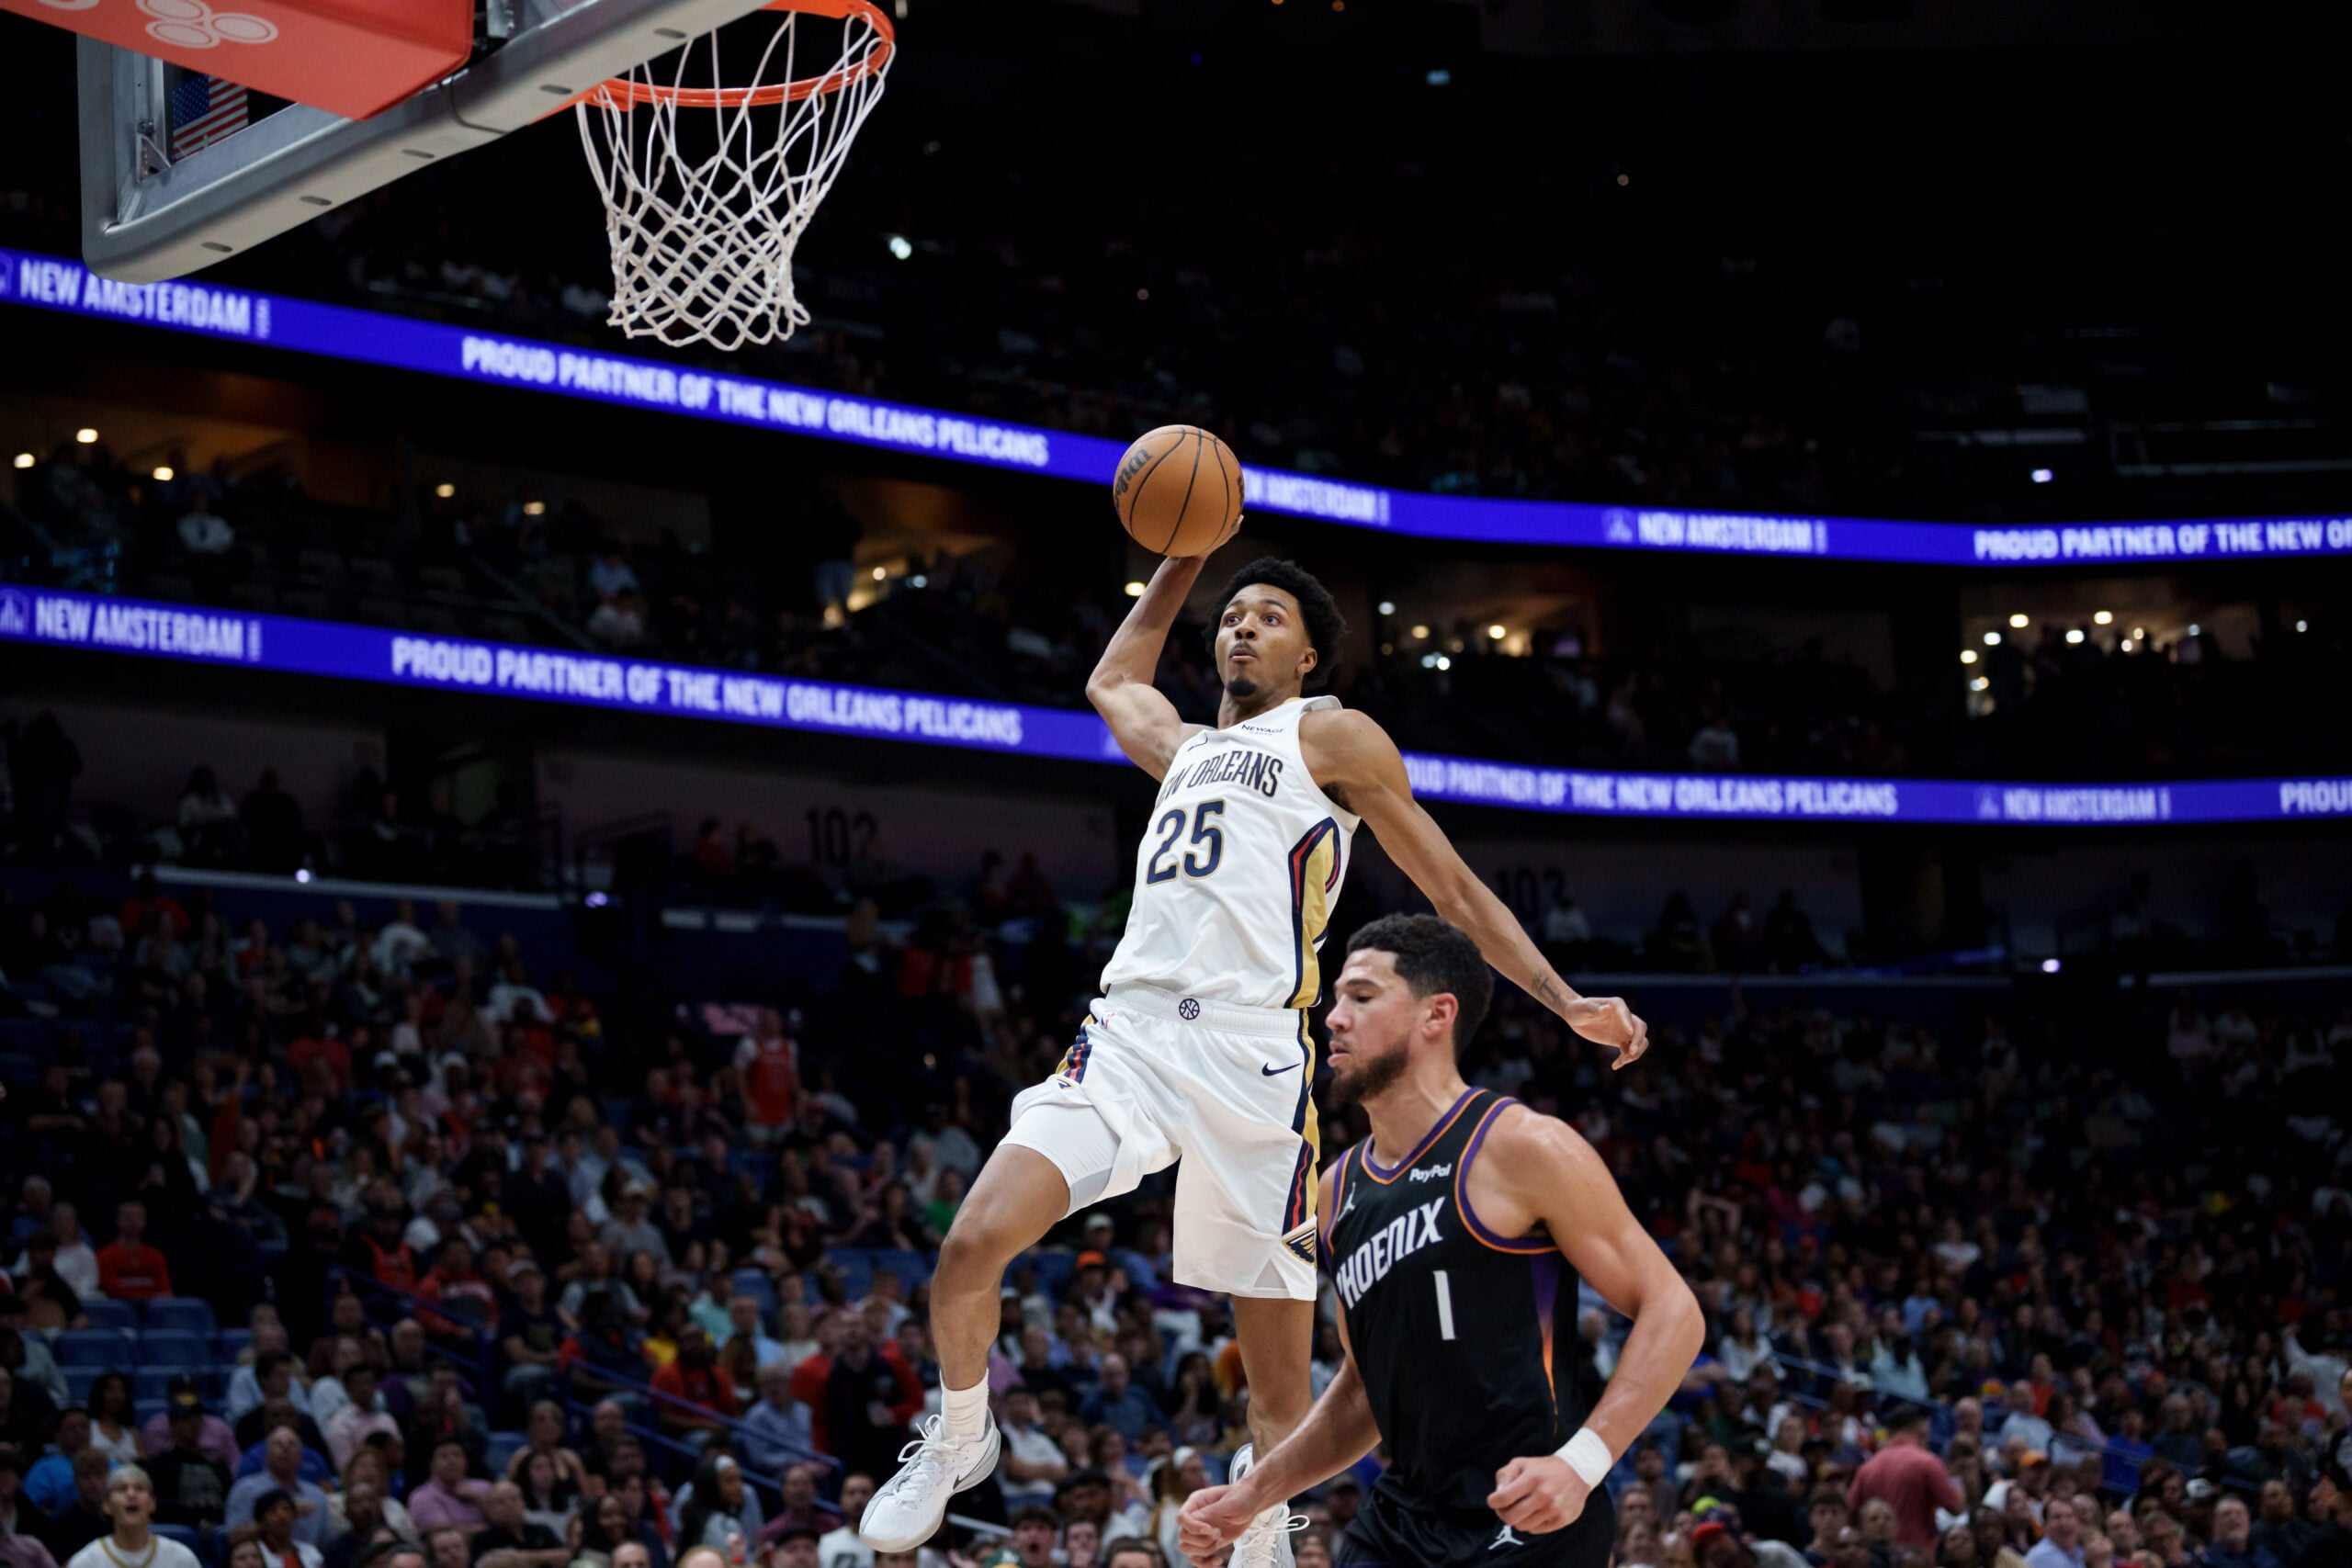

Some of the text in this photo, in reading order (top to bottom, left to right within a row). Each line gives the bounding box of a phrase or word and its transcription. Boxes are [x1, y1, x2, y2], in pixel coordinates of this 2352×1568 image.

[20, 258, 82, 306] NEW
[83, 273, 251, 334] AMSTERDAM
[462, 336, 1049, 468] PROUD PARTNER OF THE NEW ORLEANS PELICANS
[1638, 512, 1684, 546] NEW
[1686, 513, 1812, 553] AMSTERDAM
[1973, 529, 2059, 560] PROUD
[2061, 525, 2176, 558] PARTNER
[2177, 525, 2210, 554] OF
[2213, 523, 2264, 552] THE
[2266, 520, 2323, 551] NEW
[36, 595, 91, 641] NEW
[93, 603, 243, 660] AMSTERDAM
[392, 637, 1023, 746] PROUD PARTNER OF THE NEW ORLEANS PELICANS
[1186, 750, 1283, 798] ORLEANS
[1446, 761, 1537, 802] PARTNER
[1539, 772, 1566, 806] OF
[1570, 773, 1614, 808] THE
[1617, 777, 1672, 811] NEW
[1675, 778, 1783, 813] ORLEANS
[1785, 780, 1898, 816] PELICANS
[2004, 787, 2041, 819] NEW
[2043, 788, 2156, 821] AMSTERDAM
[1146, 797, 1227, 887] 25
[1409, 1163, 1452, 1182] PayPal
[1432, 1269, 1455, 1341] 1
